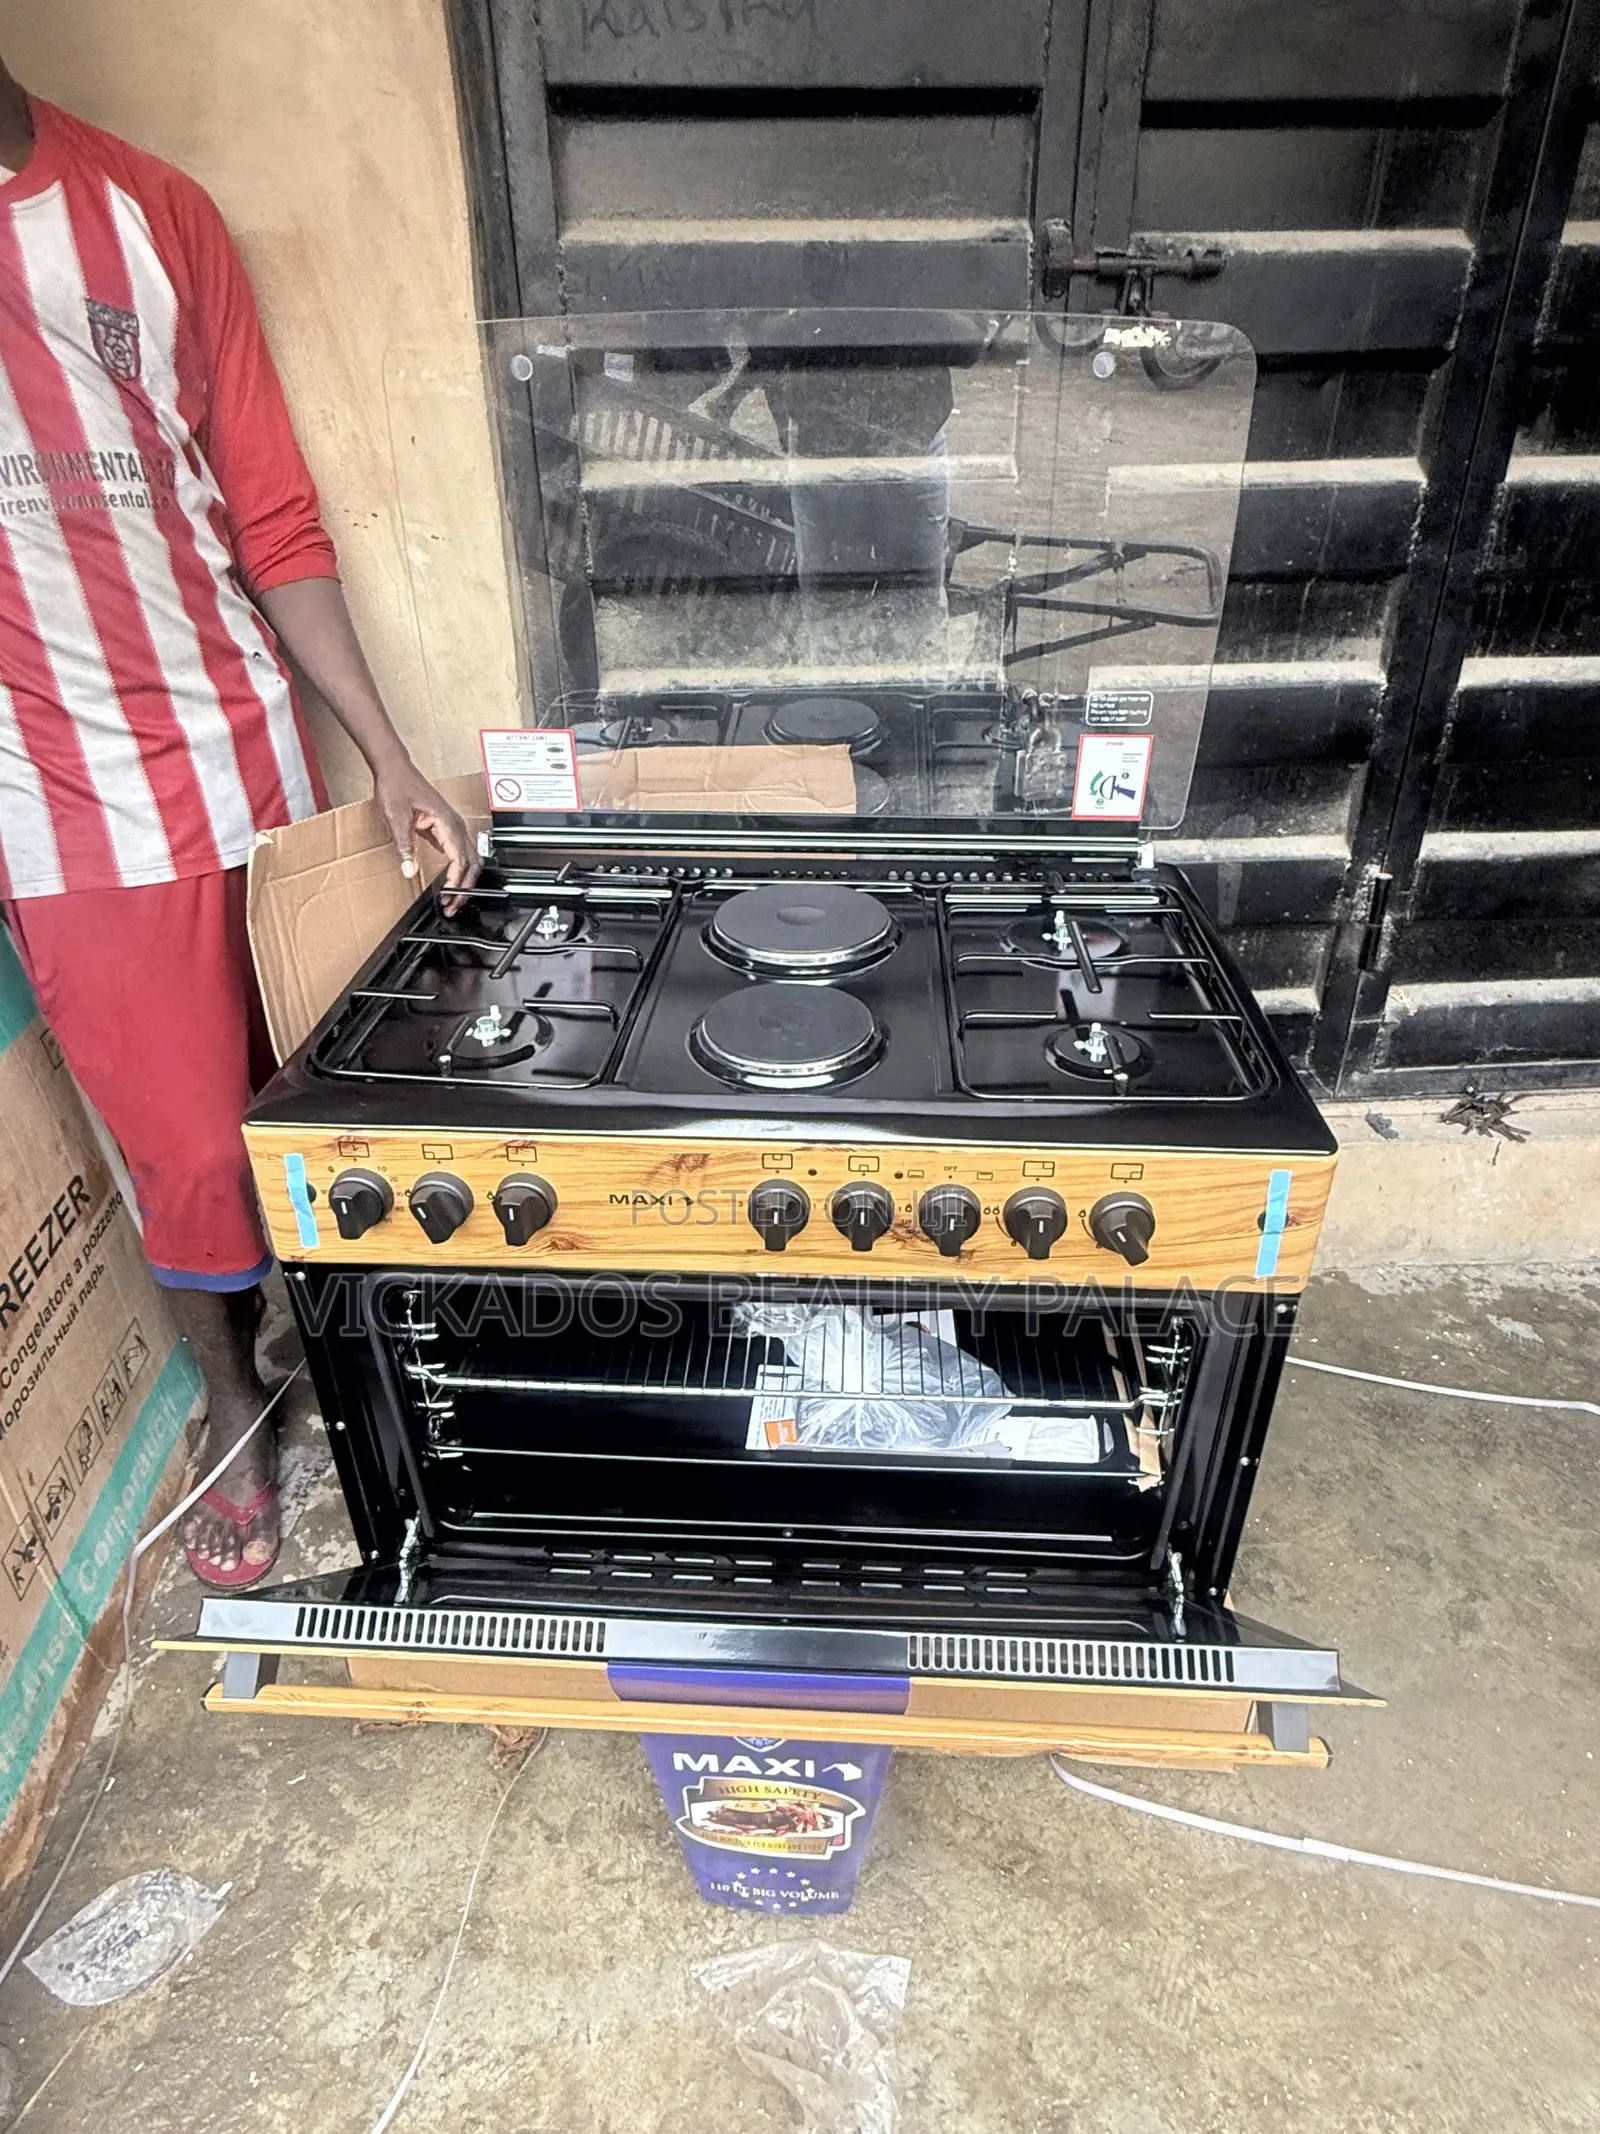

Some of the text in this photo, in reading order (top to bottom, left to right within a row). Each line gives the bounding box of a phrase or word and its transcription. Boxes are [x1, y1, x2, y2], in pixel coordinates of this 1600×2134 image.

[609, 1194, 672, 1206] MAXI
[0, 1191, 122, 1389] Congelatore a pozzetto
[80, 1263, 105, 1306] ларь
[673, 1752, 815, 1778] MAXI
[719, 1786, 759, 1795] HIGH
[753, 1887, 776, 1897] BIG
